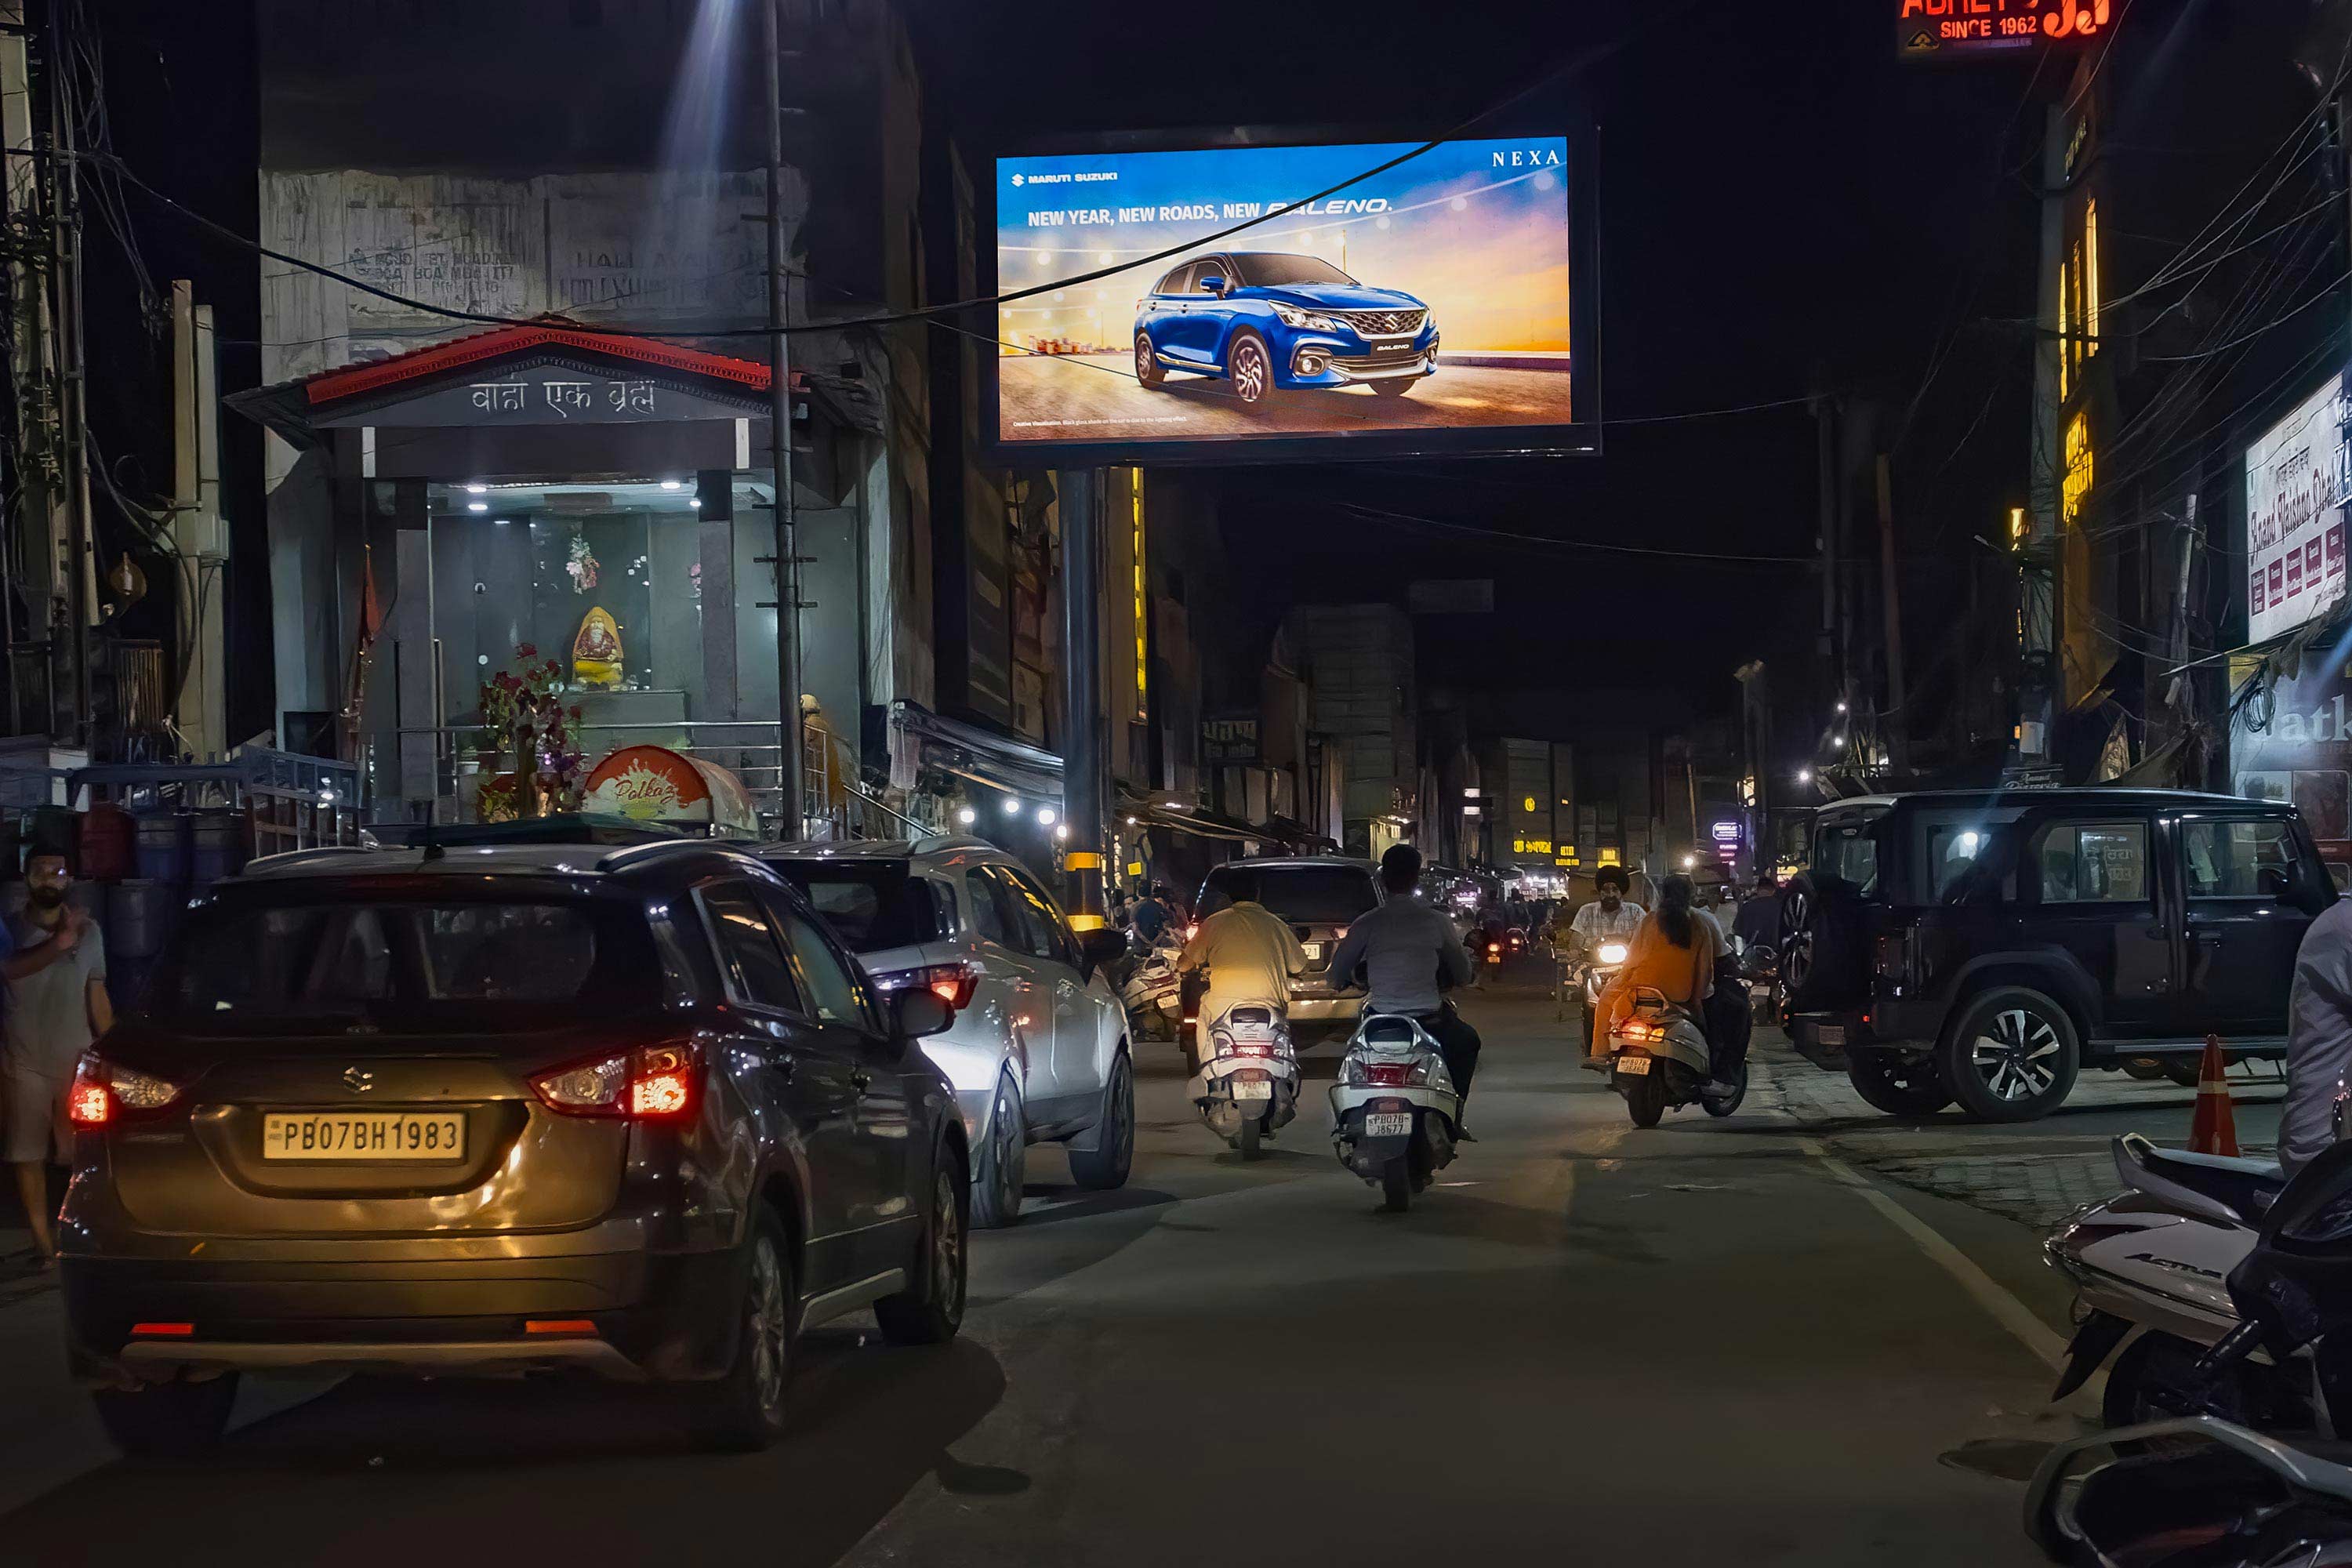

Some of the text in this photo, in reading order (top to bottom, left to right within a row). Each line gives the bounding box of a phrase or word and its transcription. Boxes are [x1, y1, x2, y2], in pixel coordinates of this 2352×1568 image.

[1940, 20, 1991, 38] SINCE
[1999, 16, 2037, 34] 1962
[1493, 149, 1560, 167] NEXA
[1029, 172, 1118, 184] MARUTI SUZUKI
[1028, 211, 1065, 227] NEW
[1068, 209, 1115, 227] YEAR,
[1119, 206, 1155, 222] NEW
[1160, 205, 1219, 223] ROADS,
[1223, 202, 1261, 219] NEW
[543, 381, 592, 418] एक
[285, 1121, 457, 1150] PB07BH1983
